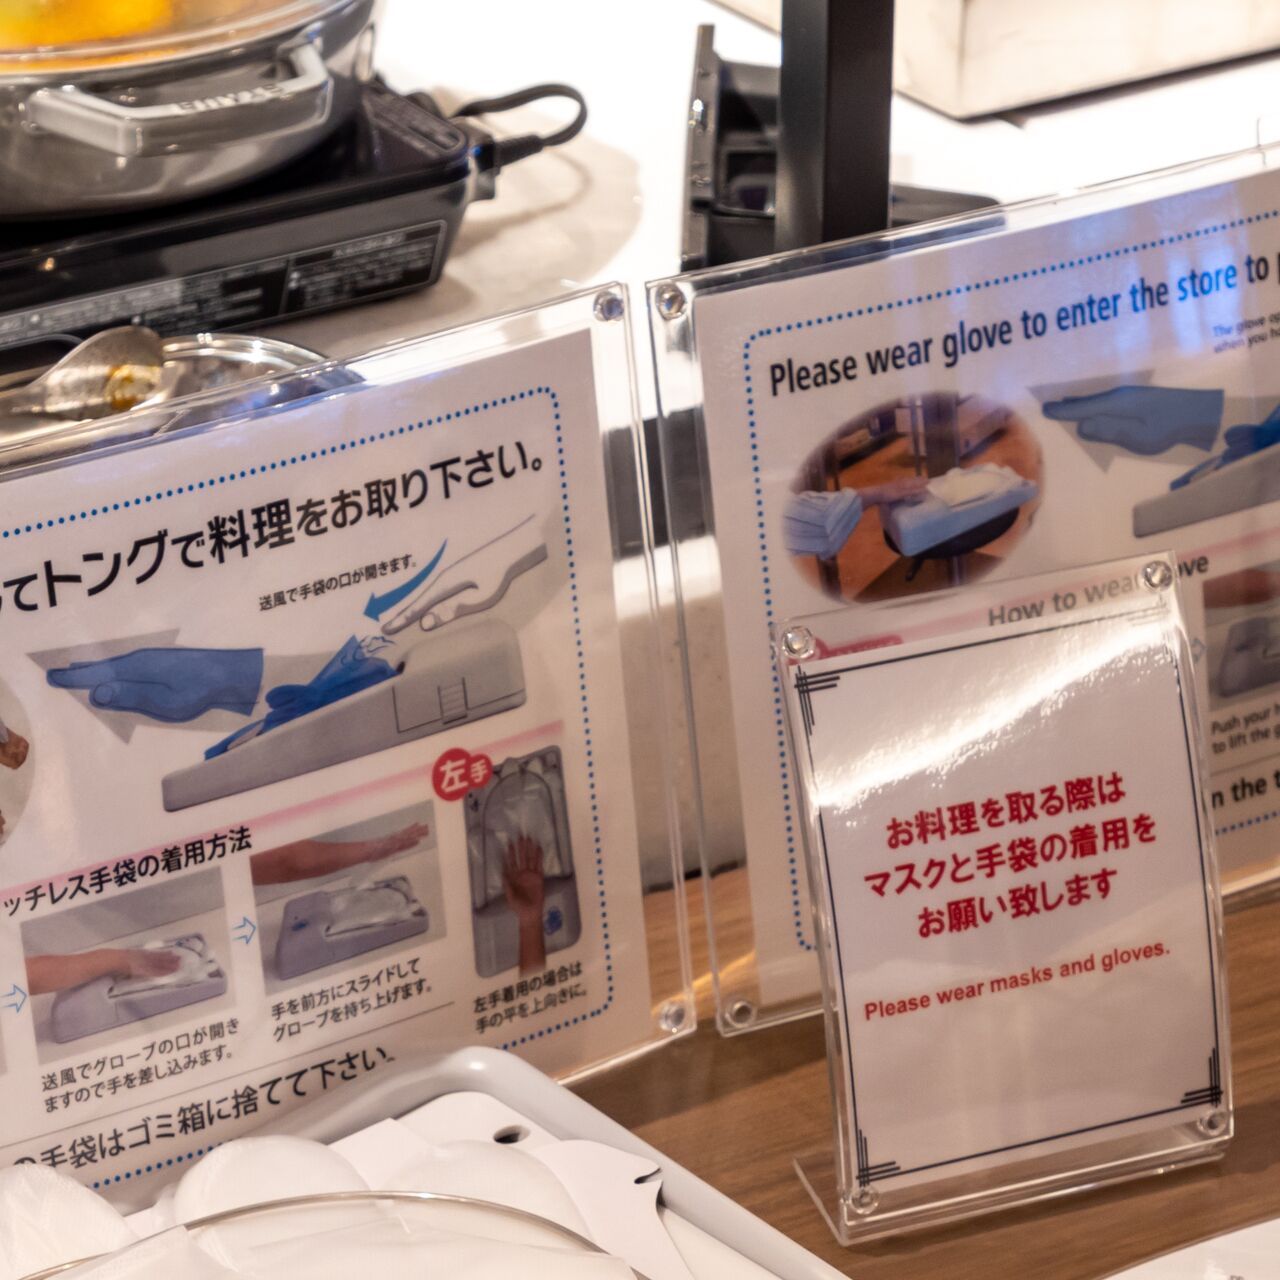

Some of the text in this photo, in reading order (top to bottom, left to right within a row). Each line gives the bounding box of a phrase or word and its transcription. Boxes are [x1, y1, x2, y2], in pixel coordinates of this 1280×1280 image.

[770, 355, 858, 397] Please
[866, 337, 933, 375] wear
[942, 319, 1013, 368] glove
[1021, 310, 1047, 340] to
[1057, 292, 1122, 331] enter
[1129, 277, 1169, 313] the
[1176, 264, 1238, 302] store
[1245, 254, 1269, 283] to
[988, 574, 1141, 627] How to wear
[1211, 741, 1227, 755] to
[1229, 733, 1248, 750] lift
[1250, 727, 1270, 743] the
[1243, 707, 1272, 727] your
[439, 757, 489, 794] 左手
[1231, 777, 1268, 803] the
[885, 771, 1127, 850] お料理を取る際は
[863, 813, 1157, 898] マスクと手袋の着用を
[917, 867, 1118, 939] お願い致します
[271, 957, 421, 1021] 手を前方にスライドして
[272, 978, 433, 1042] グローブを持ち上げます。
[864, 941, 1171, 1021] Please wear masks and gloves.
[41, 1017, 240, 1093] 送風でグローブの口が開き
[44, 1044, 234, 1113] ますので手を差し込みます。
